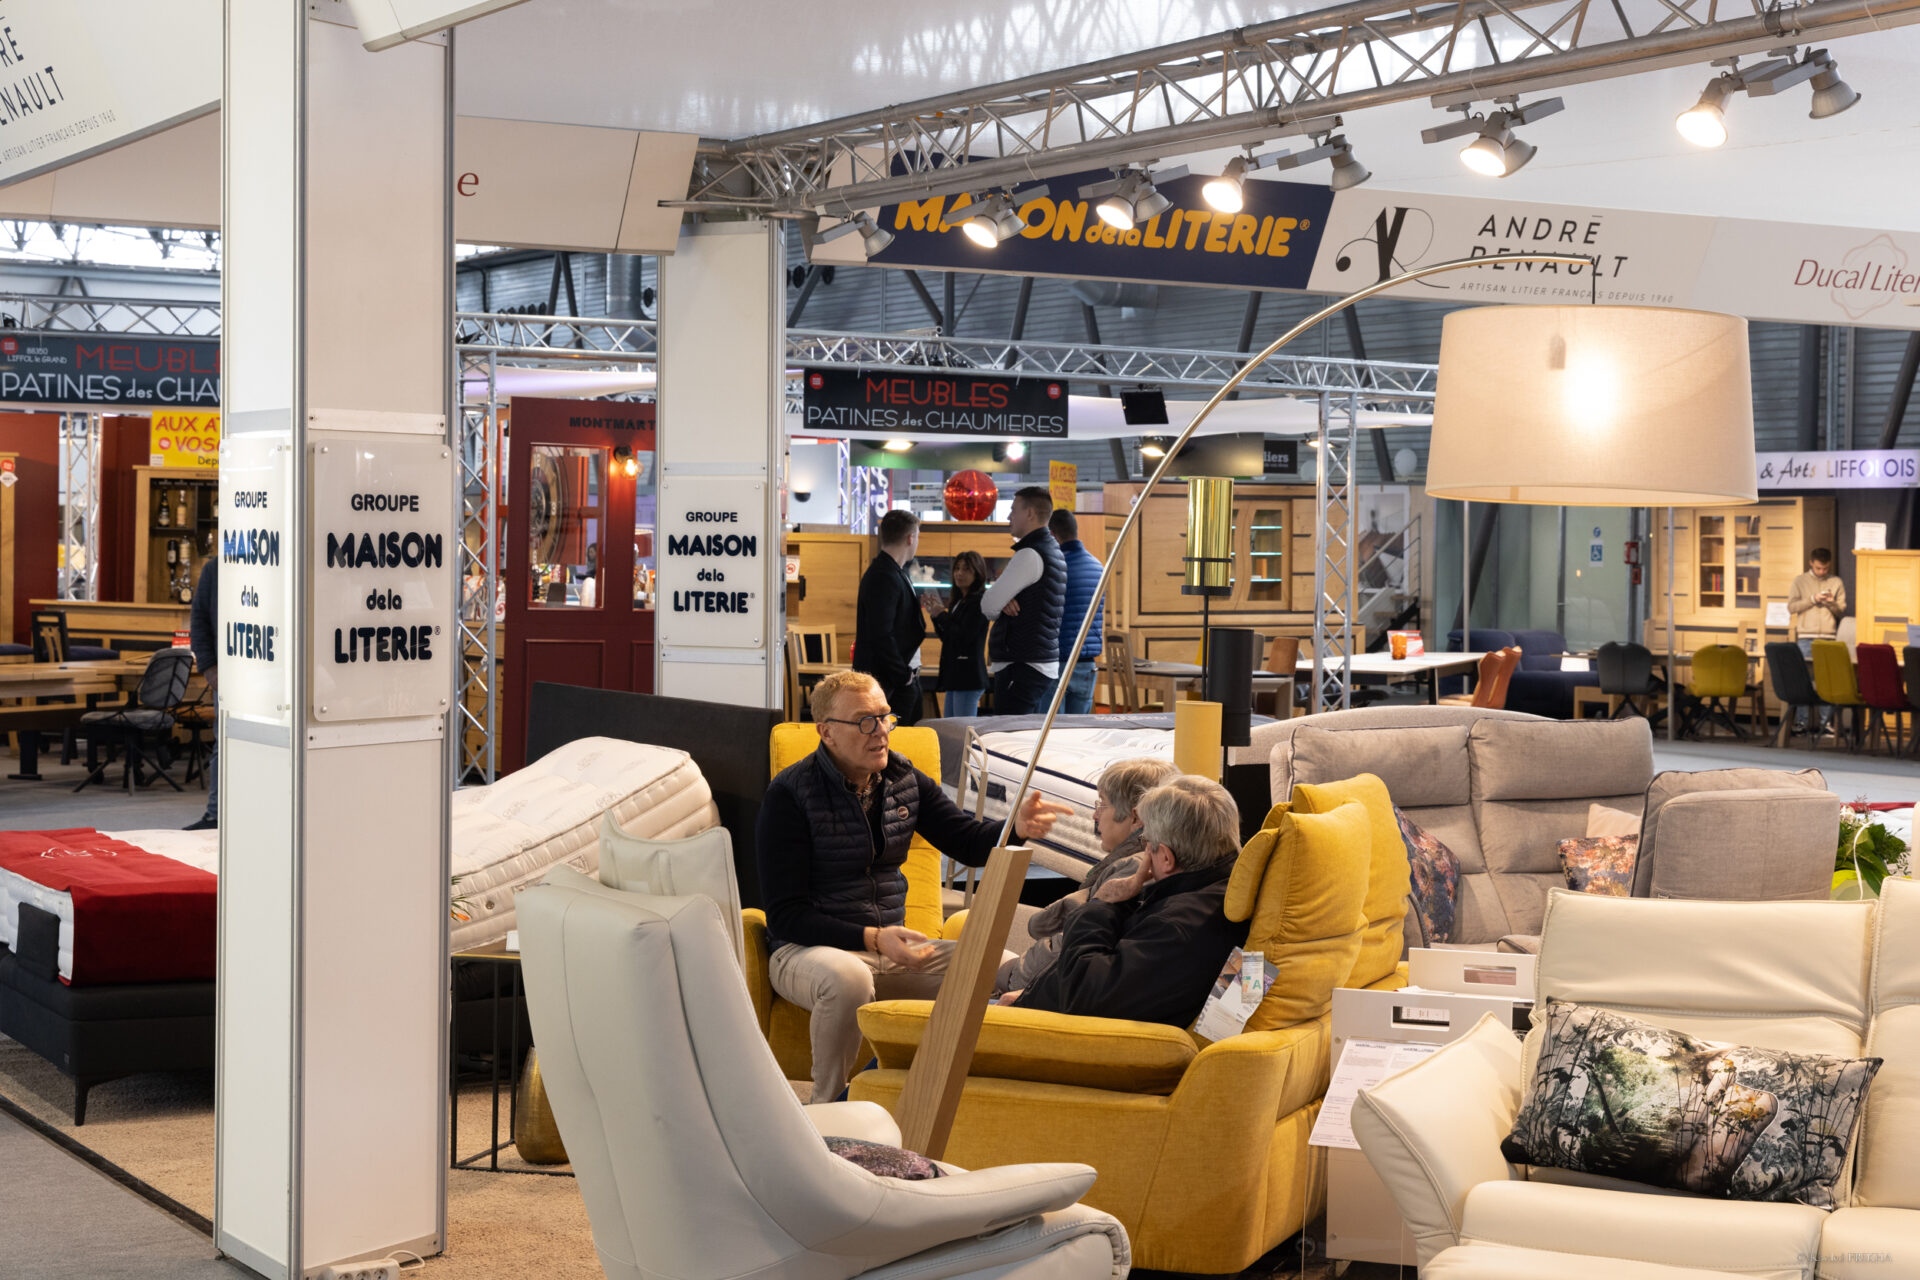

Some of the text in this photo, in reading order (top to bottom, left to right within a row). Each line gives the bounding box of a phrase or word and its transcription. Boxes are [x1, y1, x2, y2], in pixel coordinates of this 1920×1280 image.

[894, 192, 1089, 242] MAON
[1478, 214, 1603, 244] ANDRÉ
[1794, 259, 1871, 290] Ducal
[1460, 282, 1507, 293] ARTISAN
[1511, 286, 1547, 296] LITIER
[1551, 288, 1604, 300] FRANÇAS
[1608, 291, 1646, 302] DEPUIS
[41, 355, 68, 364] GRAND
[76, 343, 220, 374] MEUBL
[2, 372, 220, 402] PATINES des CHA
[866, 377, 1010, 408] MEUBLES
[155, 416, 198, 432] AUX
[807, 406, 1064, 434] PATINES des CHAUMIERES
[174, 436, 220, 453] VOS
[1777, 456, 1817, 485] Arts
[234, 491, 267, 508] GROUPE
[351, 493, 419, 512] GROUPE
[686, 511, 738, 523] GROUPE
[223, 528, 279, 566] MAISON
[327, 531, 442, 568] MAISON
[668, 534, 756, 557] MAISON
